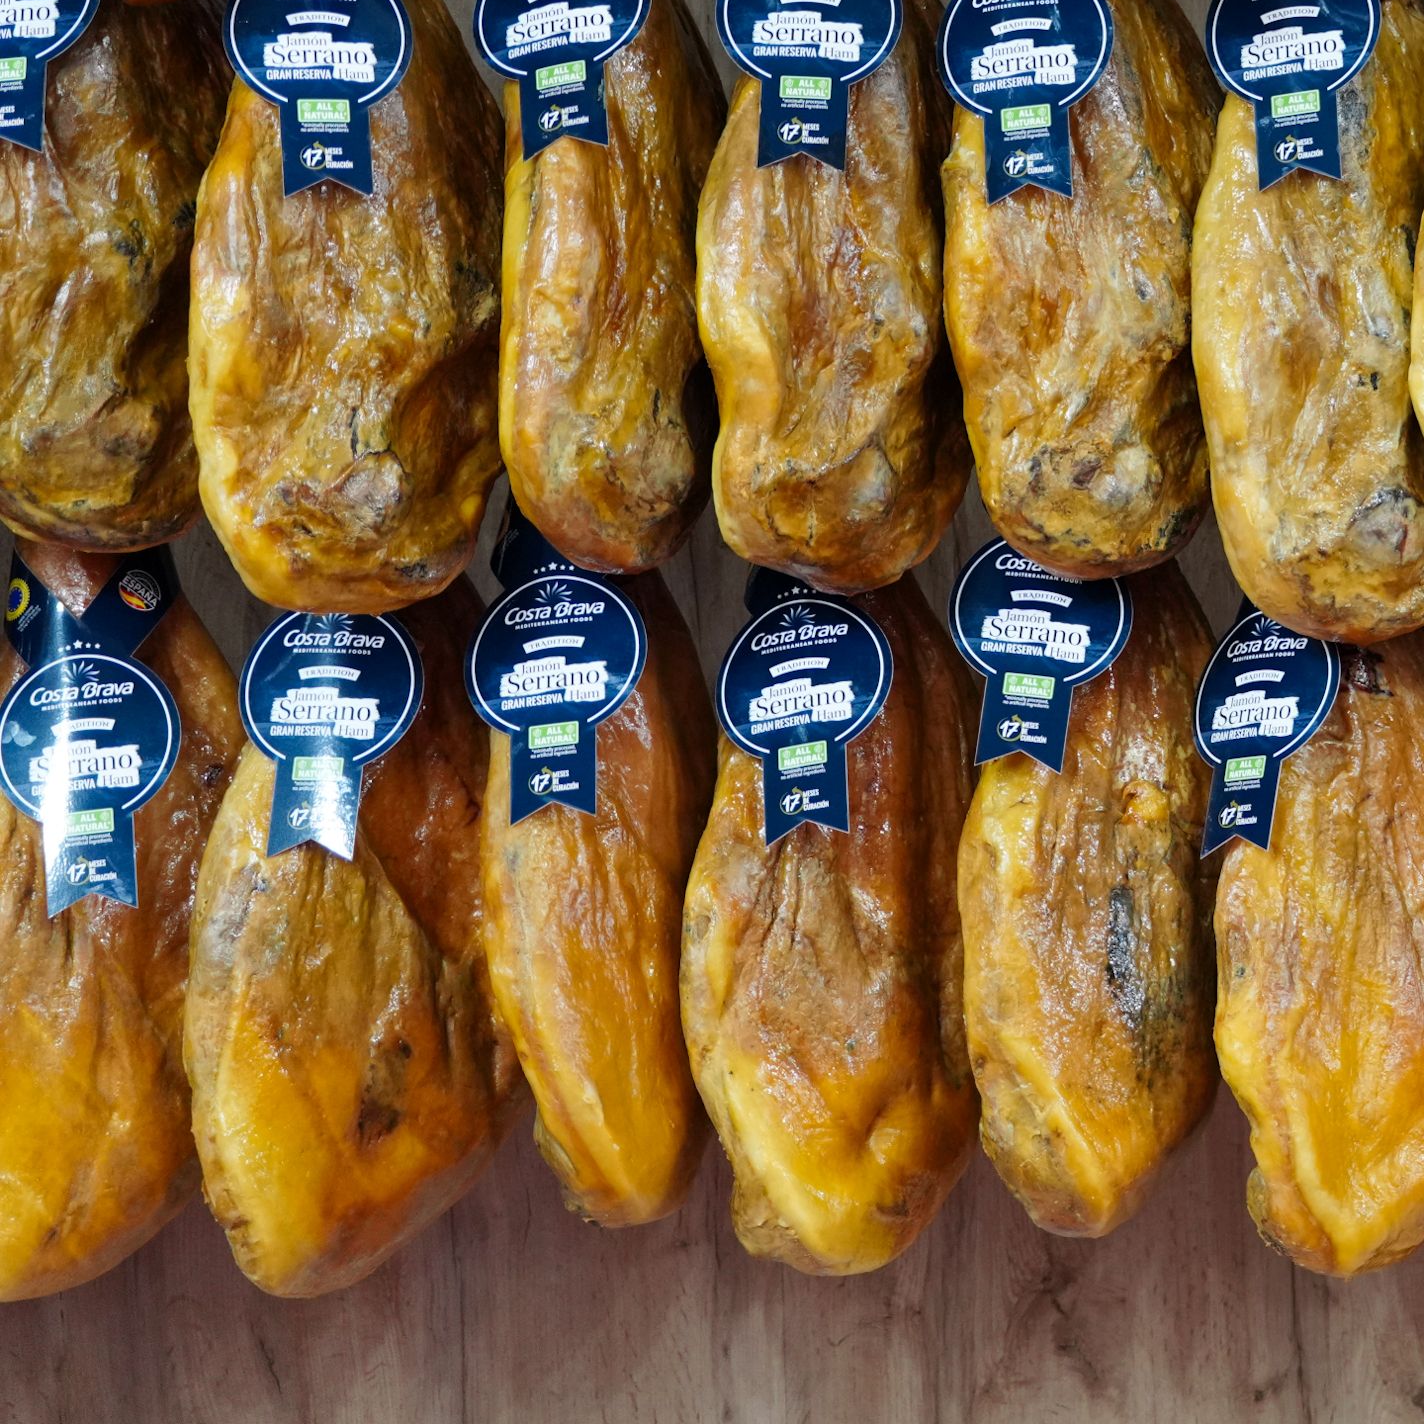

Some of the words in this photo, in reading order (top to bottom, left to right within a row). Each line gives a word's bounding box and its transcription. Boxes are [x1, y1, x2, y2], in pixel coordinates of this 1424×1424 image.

[511, 10, 605, 43] Serrano
[761, 22, 855, 45] Serrano
[271, 44, 369, 65] Serrano
[977, 51, 1070, 78] Serrano
[504, 605, 552, 626] Costa
[553, 601, 605, 618] Brava
[514, 617, 569, 631] MEDITERRANEAN
[283, 630, 332, 649] Costa
[333, 630, 385, 650] Brava
[529, 637, 579, 649] TRADITION
[750, 629, 796, 652] Costa
[797, 623, 848, 641] Brava
[1225, 639, 1263, 660] Costa
[1263, 635, 1306, 652] Brava
[521, 660, 561, 675] Jamón
[507, 668, 601, 695] Serrano
[278, 699, 371, 721] Serrano
[501, 698, 525, 712] GRAN
[526, 692, 563, 708] RESERVA
[569, 690, 600, 700] Ham
[755, 688, 846, 719] Serrano
[1217, 703, 1291, 727] Serrano
[546, 725, 563, 735] ALL
[530, 773, 550, 792] 17
[552, 769, 570, 779] MESES
[552, 781, 579, 792] CURACIÓN
